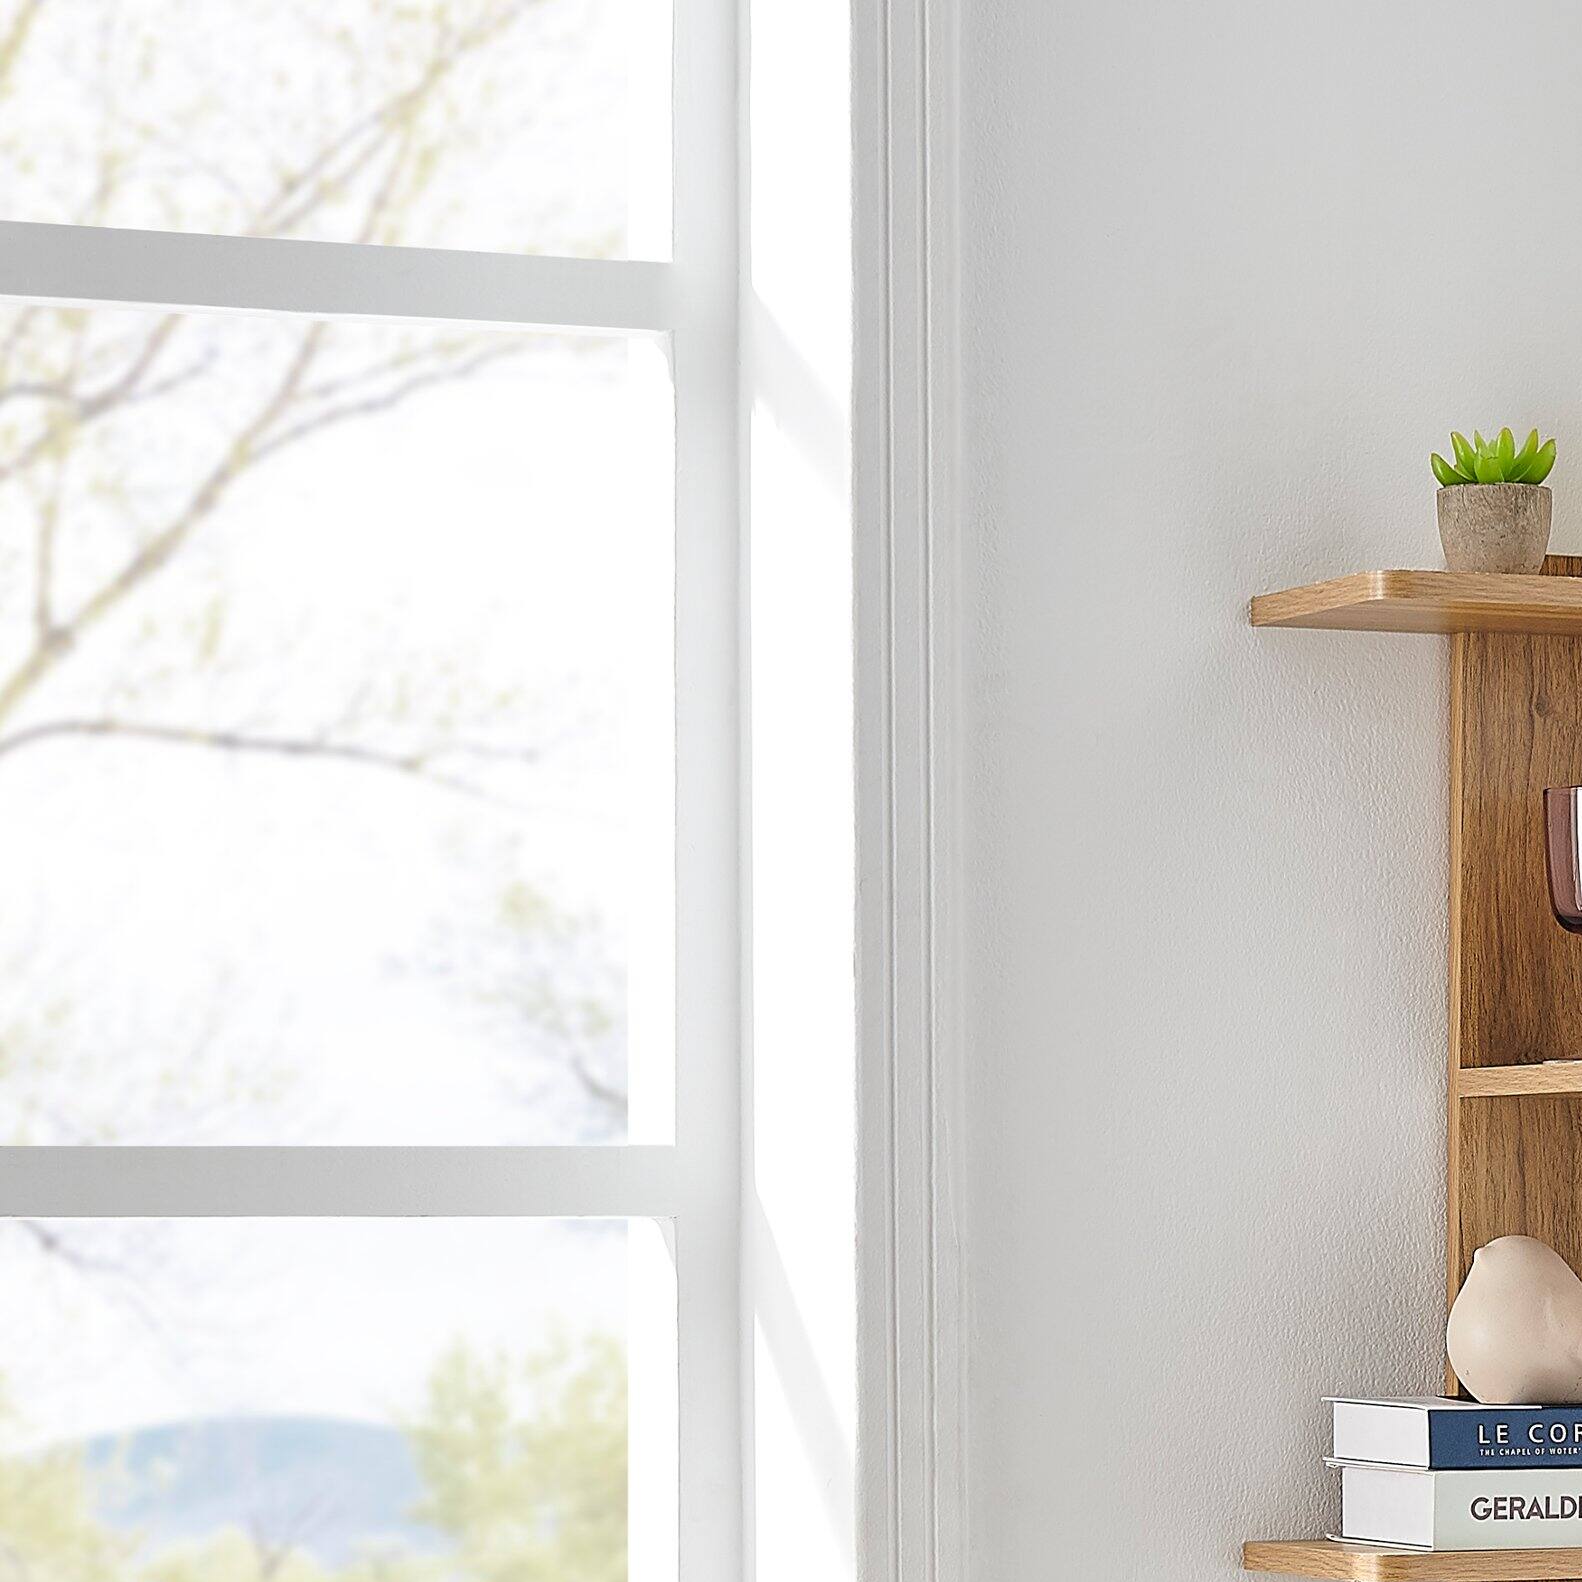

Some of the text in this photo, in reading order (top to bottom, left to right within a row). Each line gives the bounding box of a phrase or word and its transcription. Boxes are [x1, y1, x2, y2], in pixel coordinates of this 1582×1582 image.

[1477, 1424, 1509, 1444] LE
[1480, 1448, 1495, 1456] THE
[1499, 1448, 1531, 1456] CHAPEL
[1534, 1447, 1545, 1455] OF
